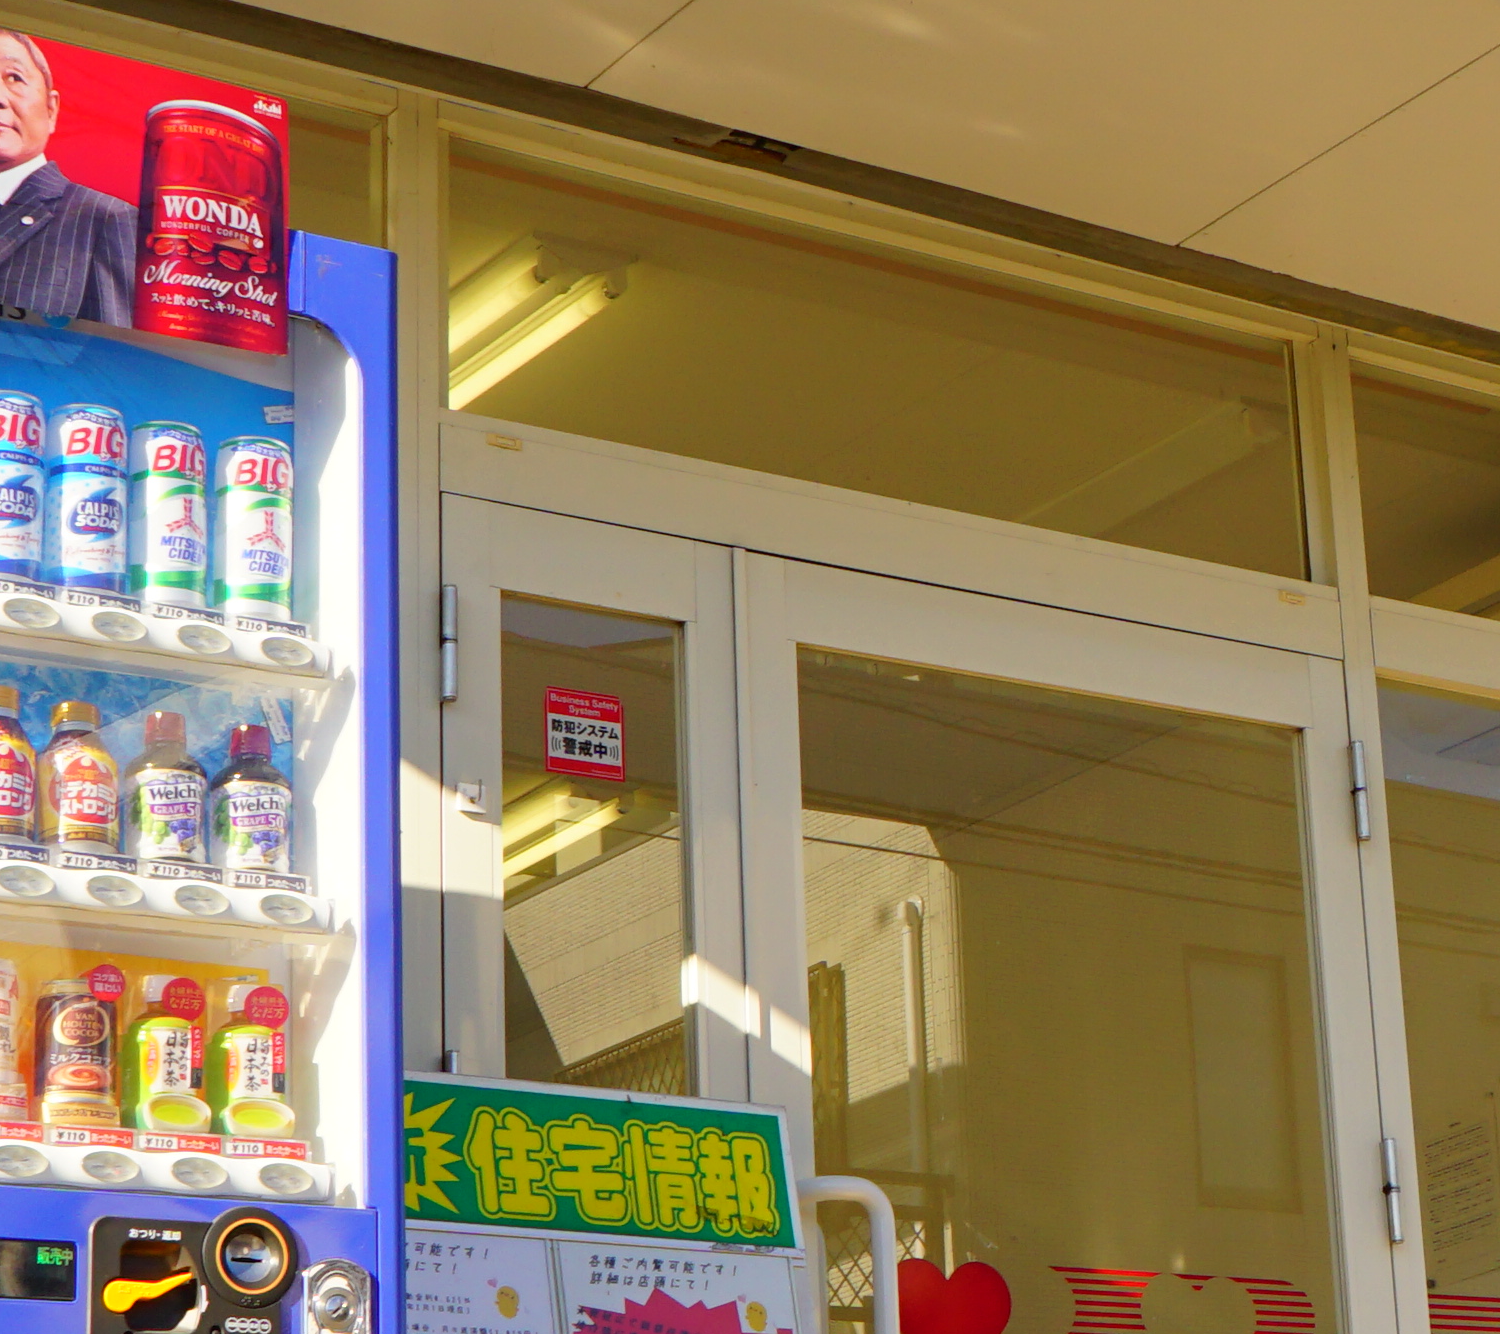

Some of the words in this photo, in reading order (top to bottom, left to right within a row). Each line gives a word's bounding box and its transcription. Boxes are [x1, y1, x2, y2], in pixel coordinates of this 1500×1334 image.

[179, 125, 204, 136] START
[162, 195, 264, 238] WONDA
[161, 220, 212, 234] WONDERFUL
[216, 227, 250, 244] COFFEE
[143, 259, 233, 299] Morning
[234, 275, 278, 307] Shot
[66, 426, 124, 459] BIG
[152, 443, 205, 473] BIG
[234, 457, 290, 490] BIG
[76, 501, 120, 522] CALPIS
[74, 514, 120, 534] SODA
[249, 560, 285, 577] CIDER
[68, 591, 96, 605] ¥110
[157, 604, 184, 618] ¥110
[236, 618, 263, 632] ¥110
[550, 692, 590, 707] Business
[551, 718, 619, 740] 防犯システム
[563, 736, 608, 759] 警戒中
[60, 799, 117, 819] ストロング
[153, 804, 186, 815] GRAPE
[187, 804, 201, 816] 50
[231, 797, 284, 814] Welch's
[236, 817, 267, 827] GRAPE
[267, 815, 284, 828] 50
[65, 854, 93, 867] ¥110
[152, 865, 180, 876] ¥110
[235, 873, 261, 883] ¥110
[57, 1131, 87, 1142] ¥110
[146, 1137, 173, 1148] ¥110
[232, 1144, 259, 1154] ¥110
[464, 1105, 781, 1239] 住宅情報
[36, 1246, 74, 1266] 販売中
